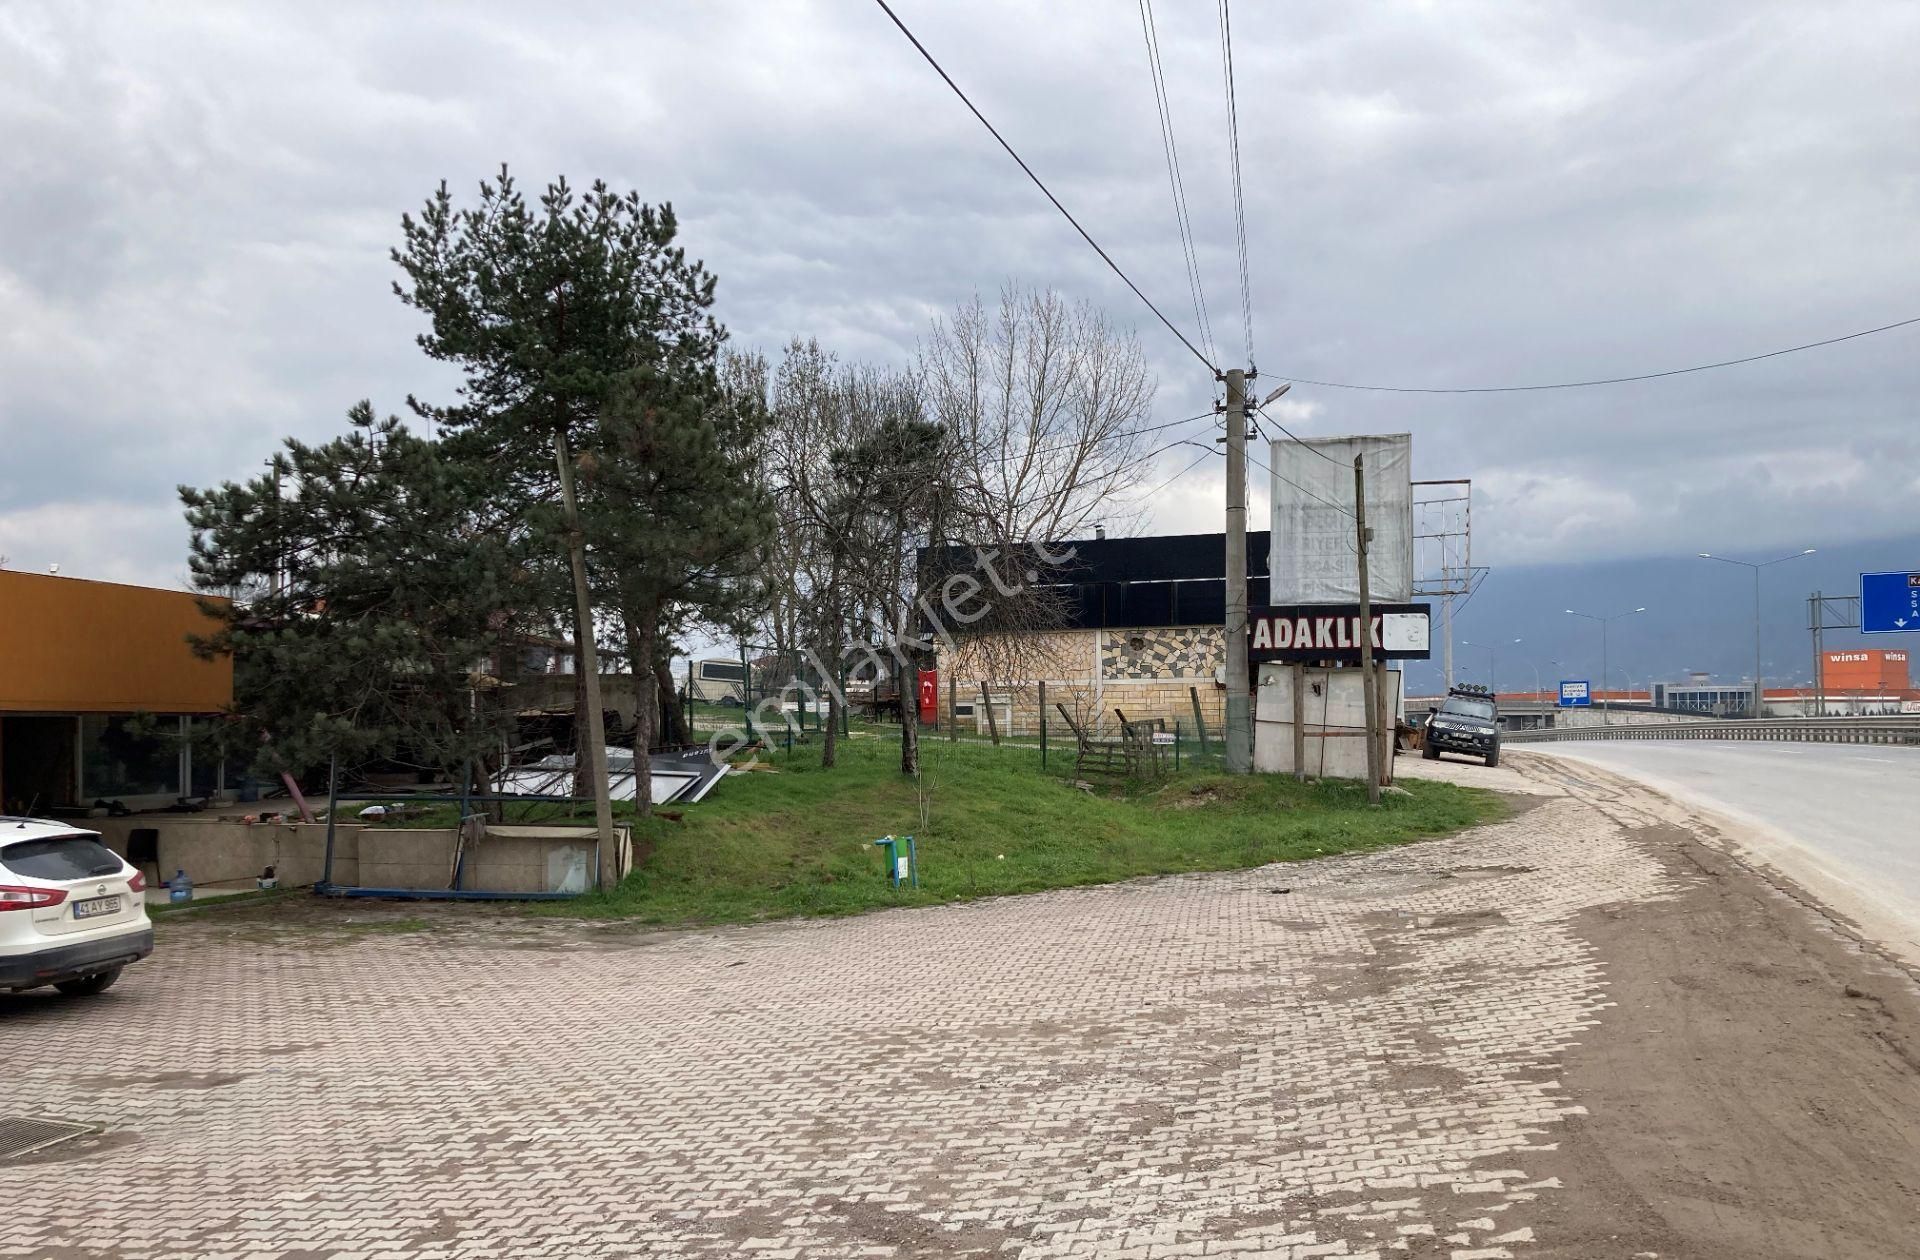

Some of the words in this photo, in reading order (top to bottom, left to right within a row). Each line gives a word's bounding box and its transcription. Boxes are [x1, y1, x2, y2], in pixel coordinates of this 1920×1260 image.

[1252, 616, 1381, 649] ADAKLIK
[1830, 653, 1869, 662] winsa
[1884, 652, 1906, 662] winsa
